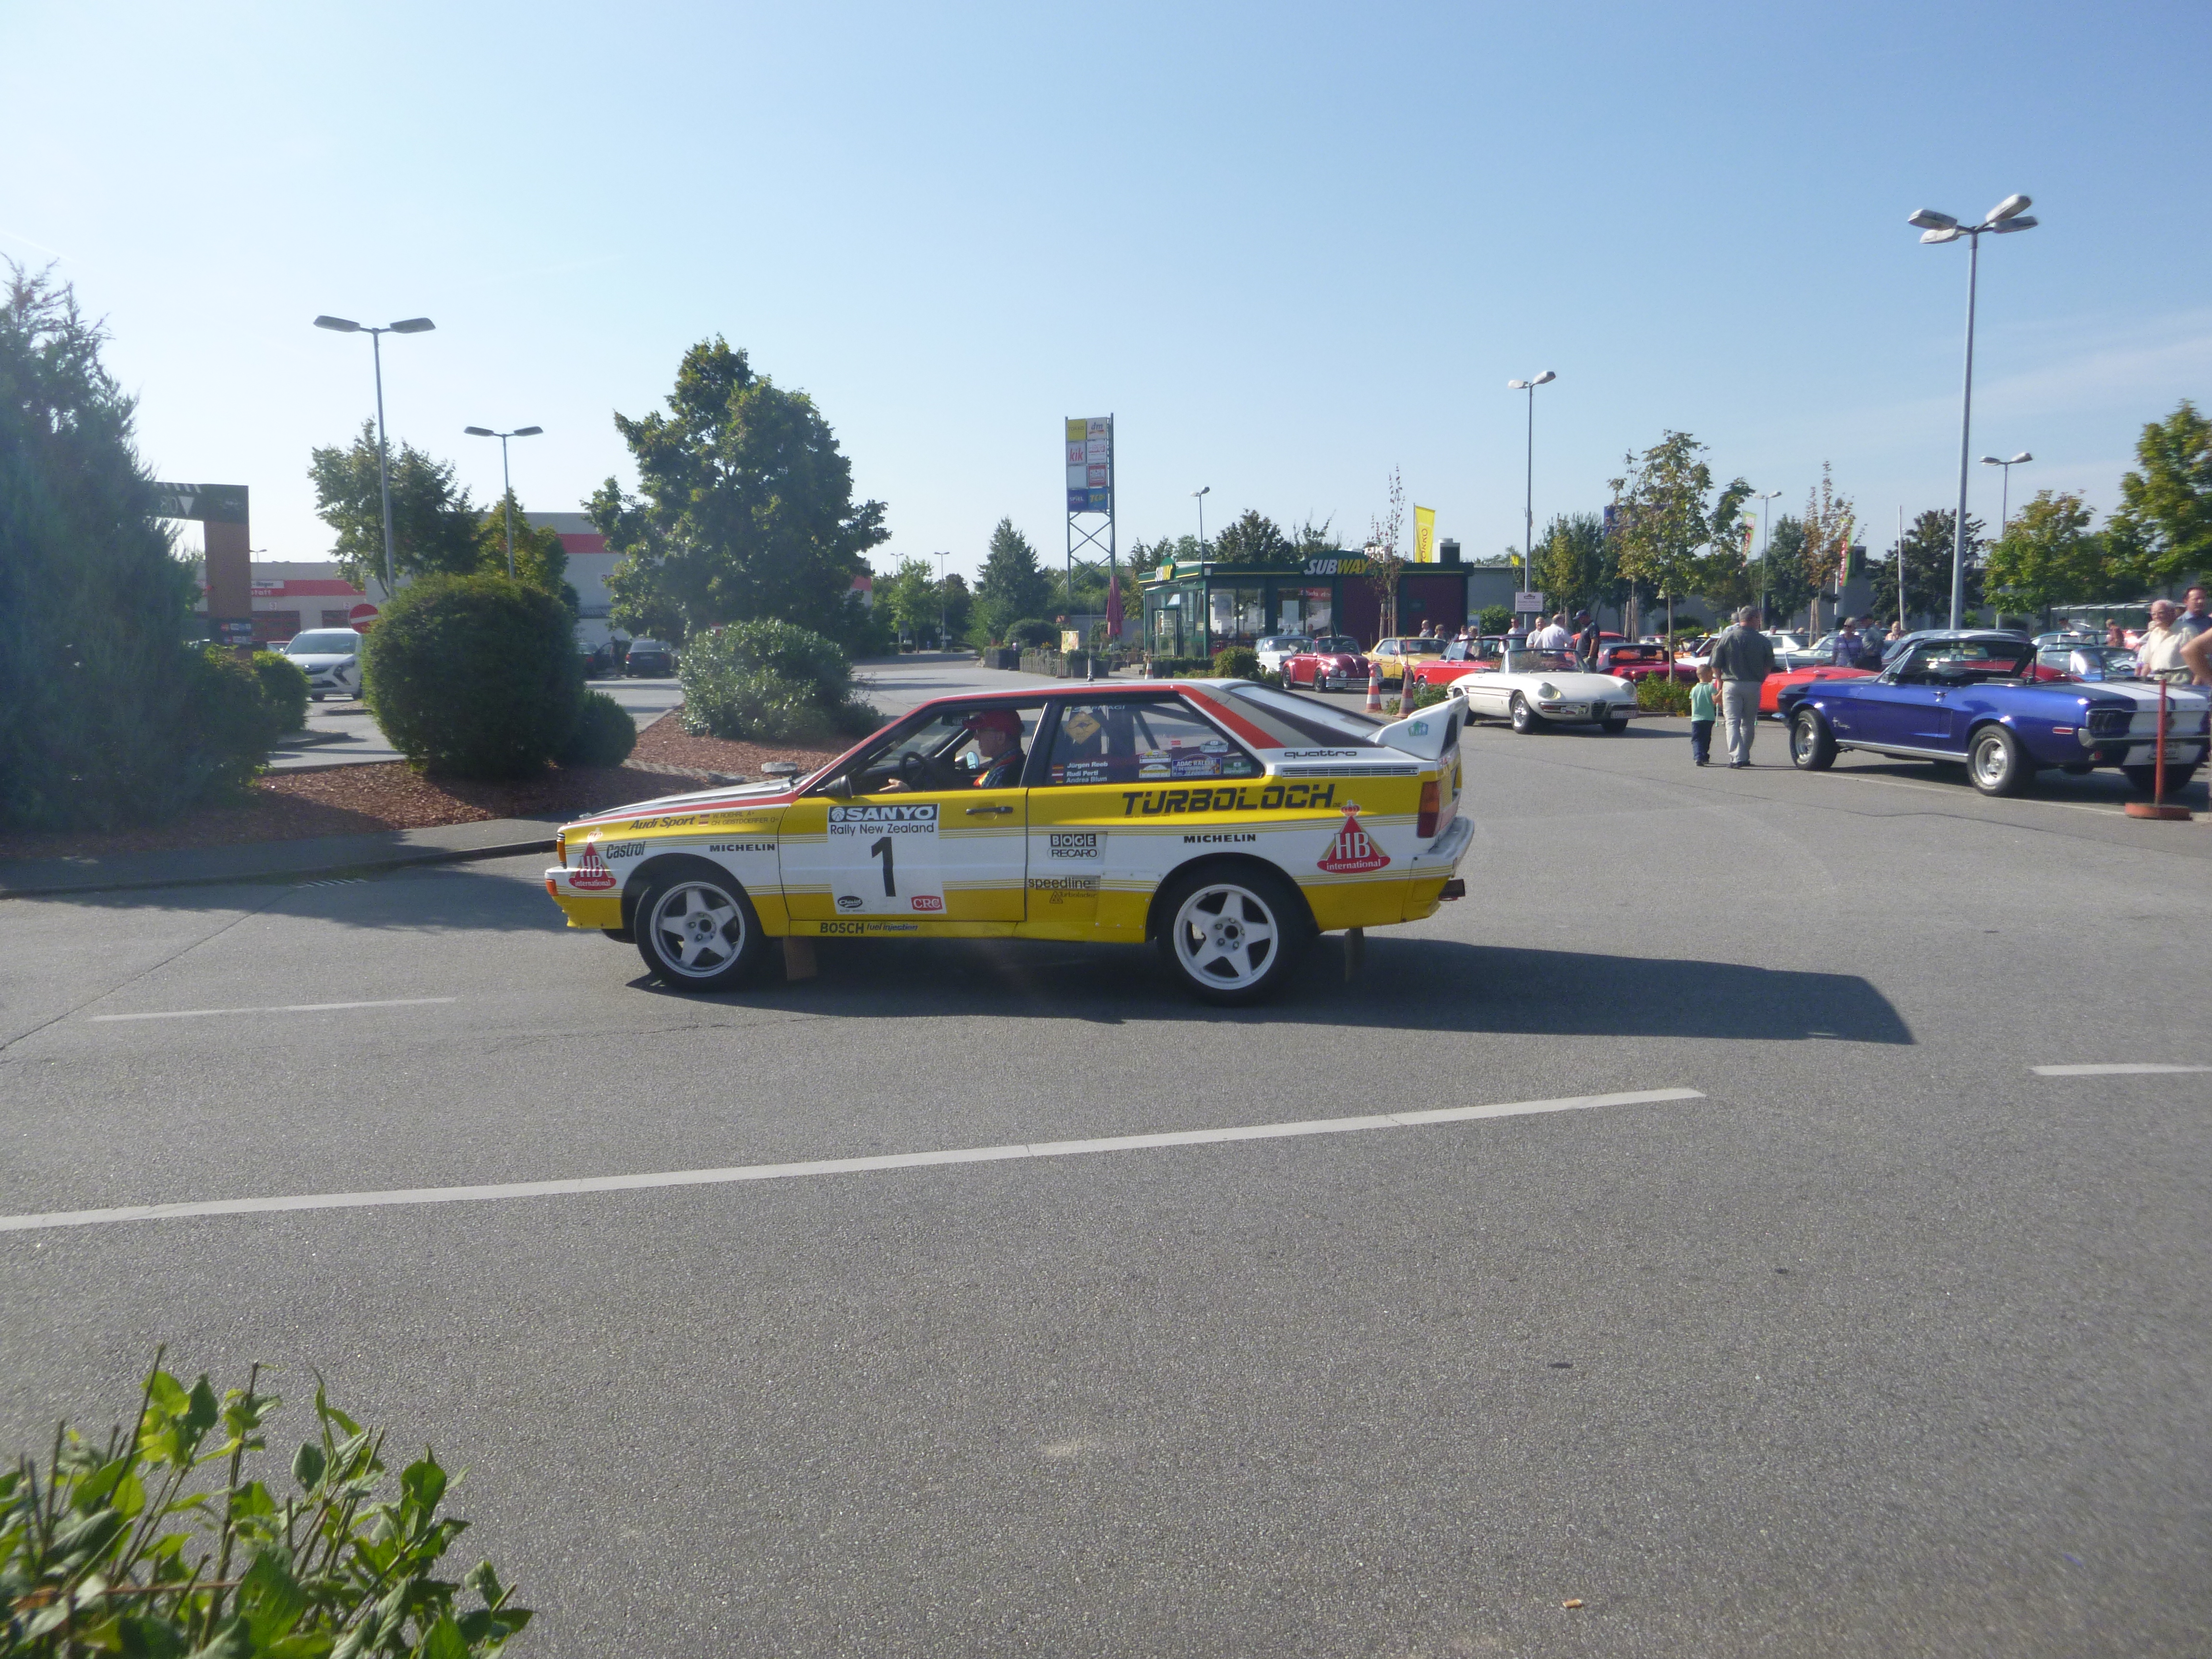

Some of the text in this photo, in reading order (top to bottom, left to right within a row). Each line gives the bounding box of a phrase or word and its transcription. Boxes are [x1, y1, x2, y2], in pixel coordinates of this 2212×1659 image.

[1304, 559, 1373, 575] SUBWAY
[1284, 750, 1358, 759] quattro
[1122, 783, 1335, 815] TURBOLOCH
[846, 806, 934, 821] SANYO
[629, 817, 696, 830] Audi Sport
[830, 822, 934, 836] Rally New Zealand
[1051, 834, 1096, 846] BOGE
[1183, 833, 1256, 843] MICHELIN
[606, 841, 646, 859] Castrol
[709, 843, 776, 852] MICHELIN
[1333, 832, 1370, 860] HB
[1051, 849, 1097, 857] RECARO
[579, 855, 603, 878] HB
[871, 837, 896, 897] 1
[1326, 859, 1381, 870] international
[1028, 877, 1091, 890] speedline
[913, 898, 940, 909] CRC
[820, 922, 864, 934] BOSCH
